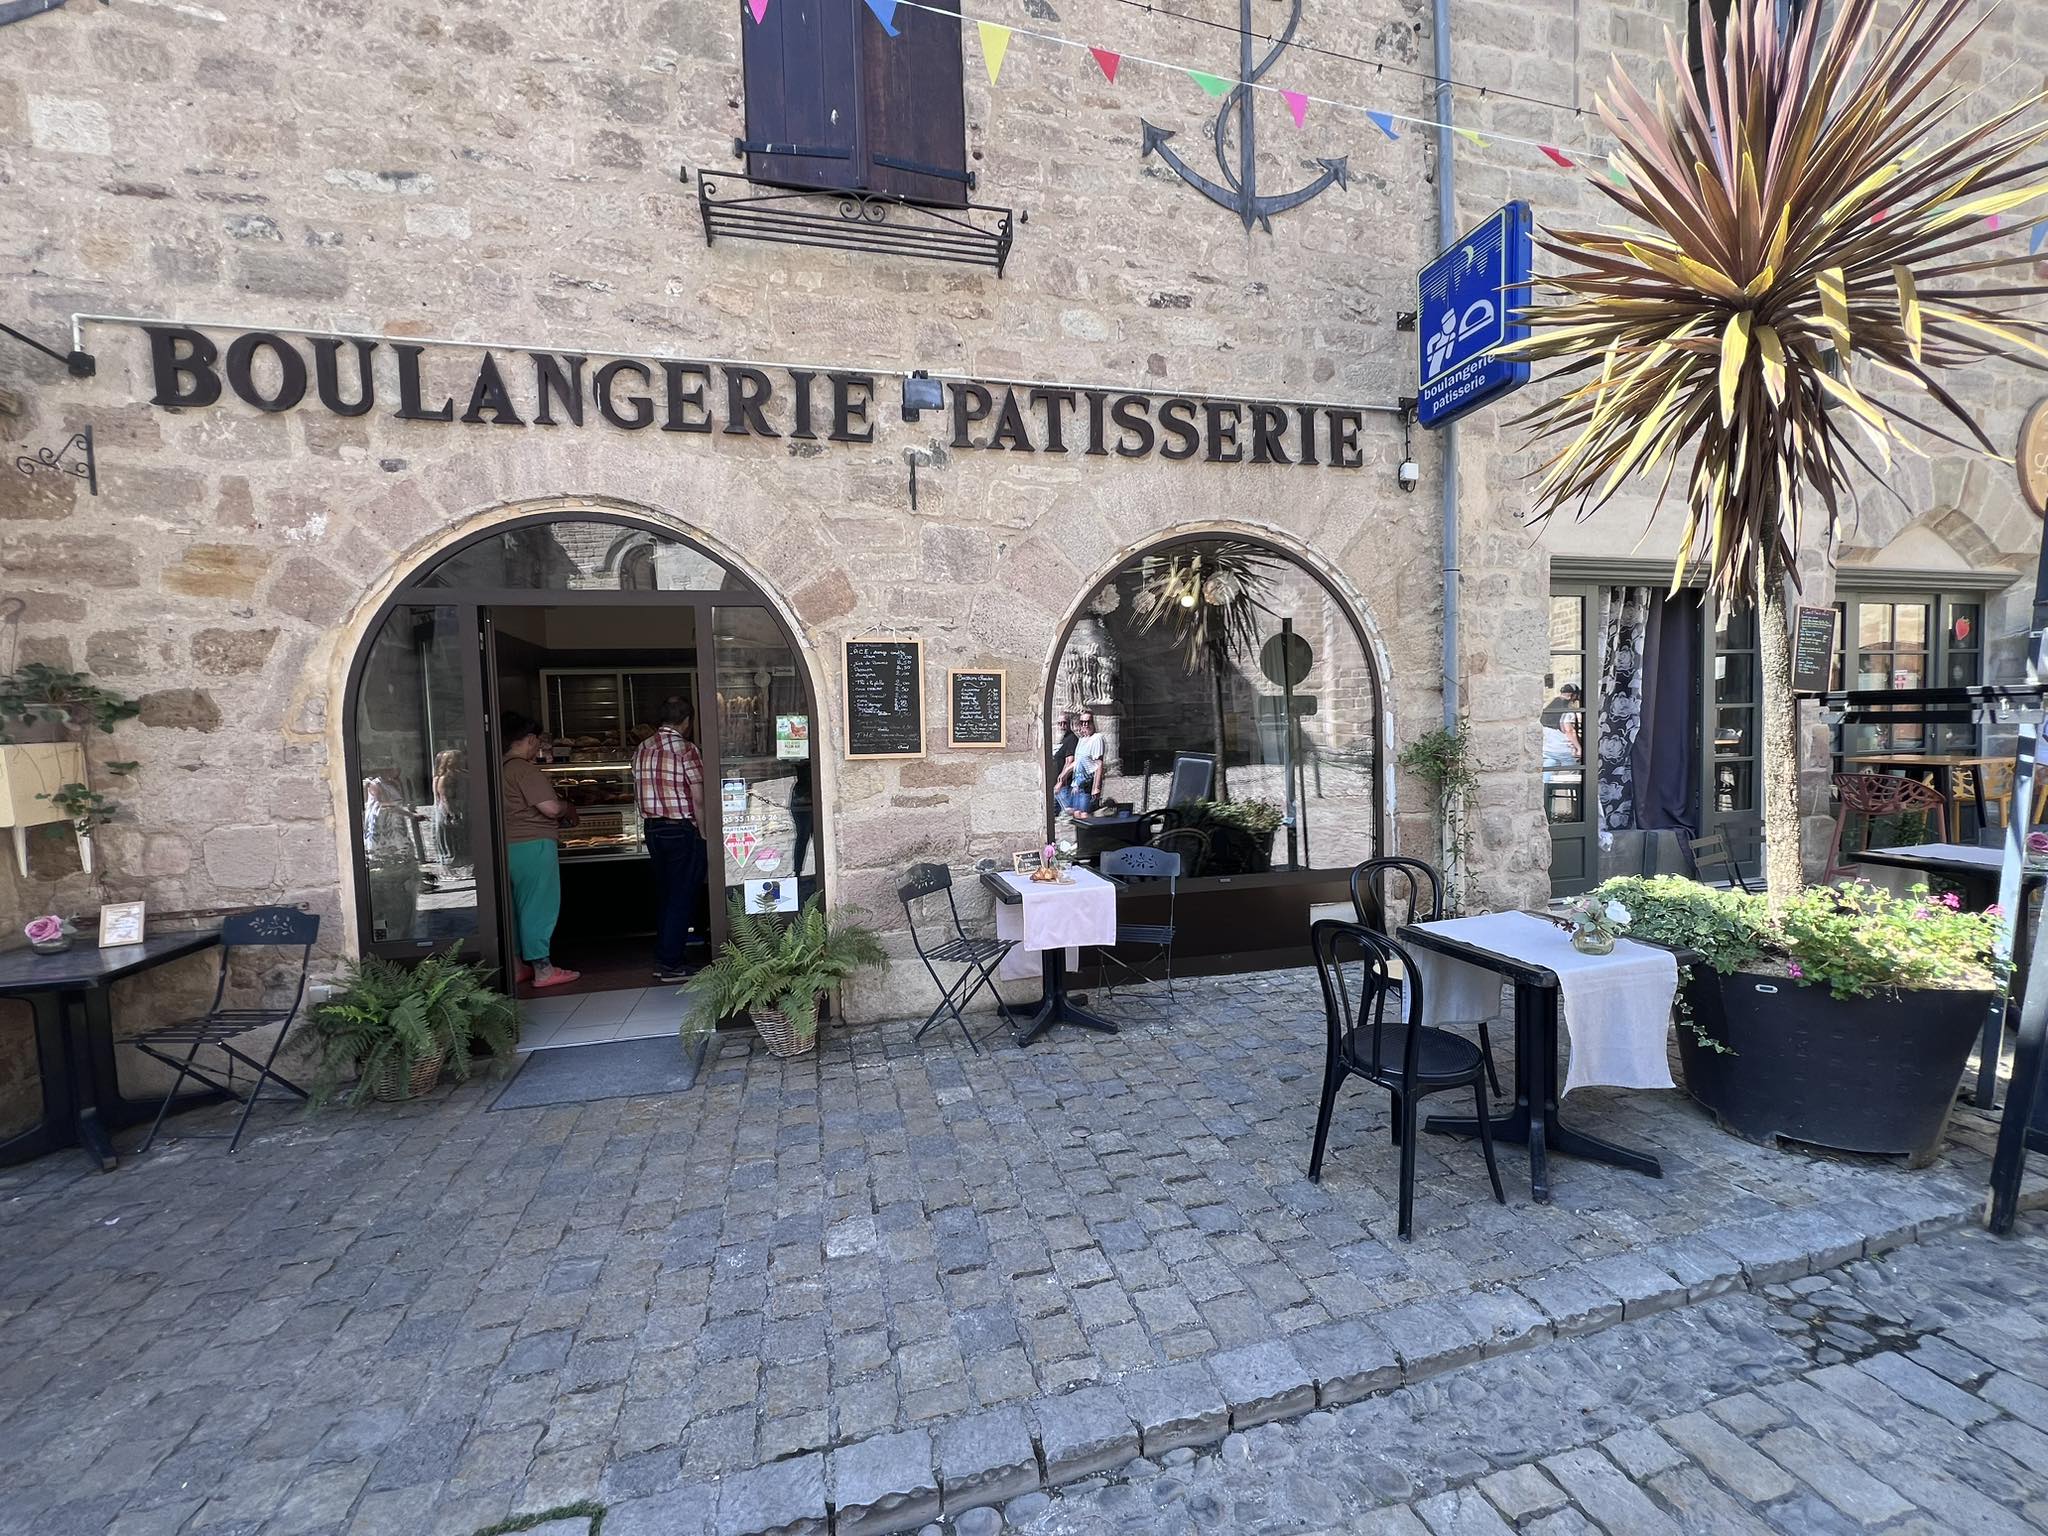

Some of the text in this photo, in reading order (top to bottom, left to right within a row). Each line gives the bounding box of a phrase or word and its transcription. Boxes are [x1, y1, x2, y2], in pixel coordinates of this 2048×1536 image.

[139, 326, 1363, 468] BOULANGERIE PATISSERIE
[1424, 353, 1495, 400] boulangerie
[1433, 374, 1486, 414] patisserie
